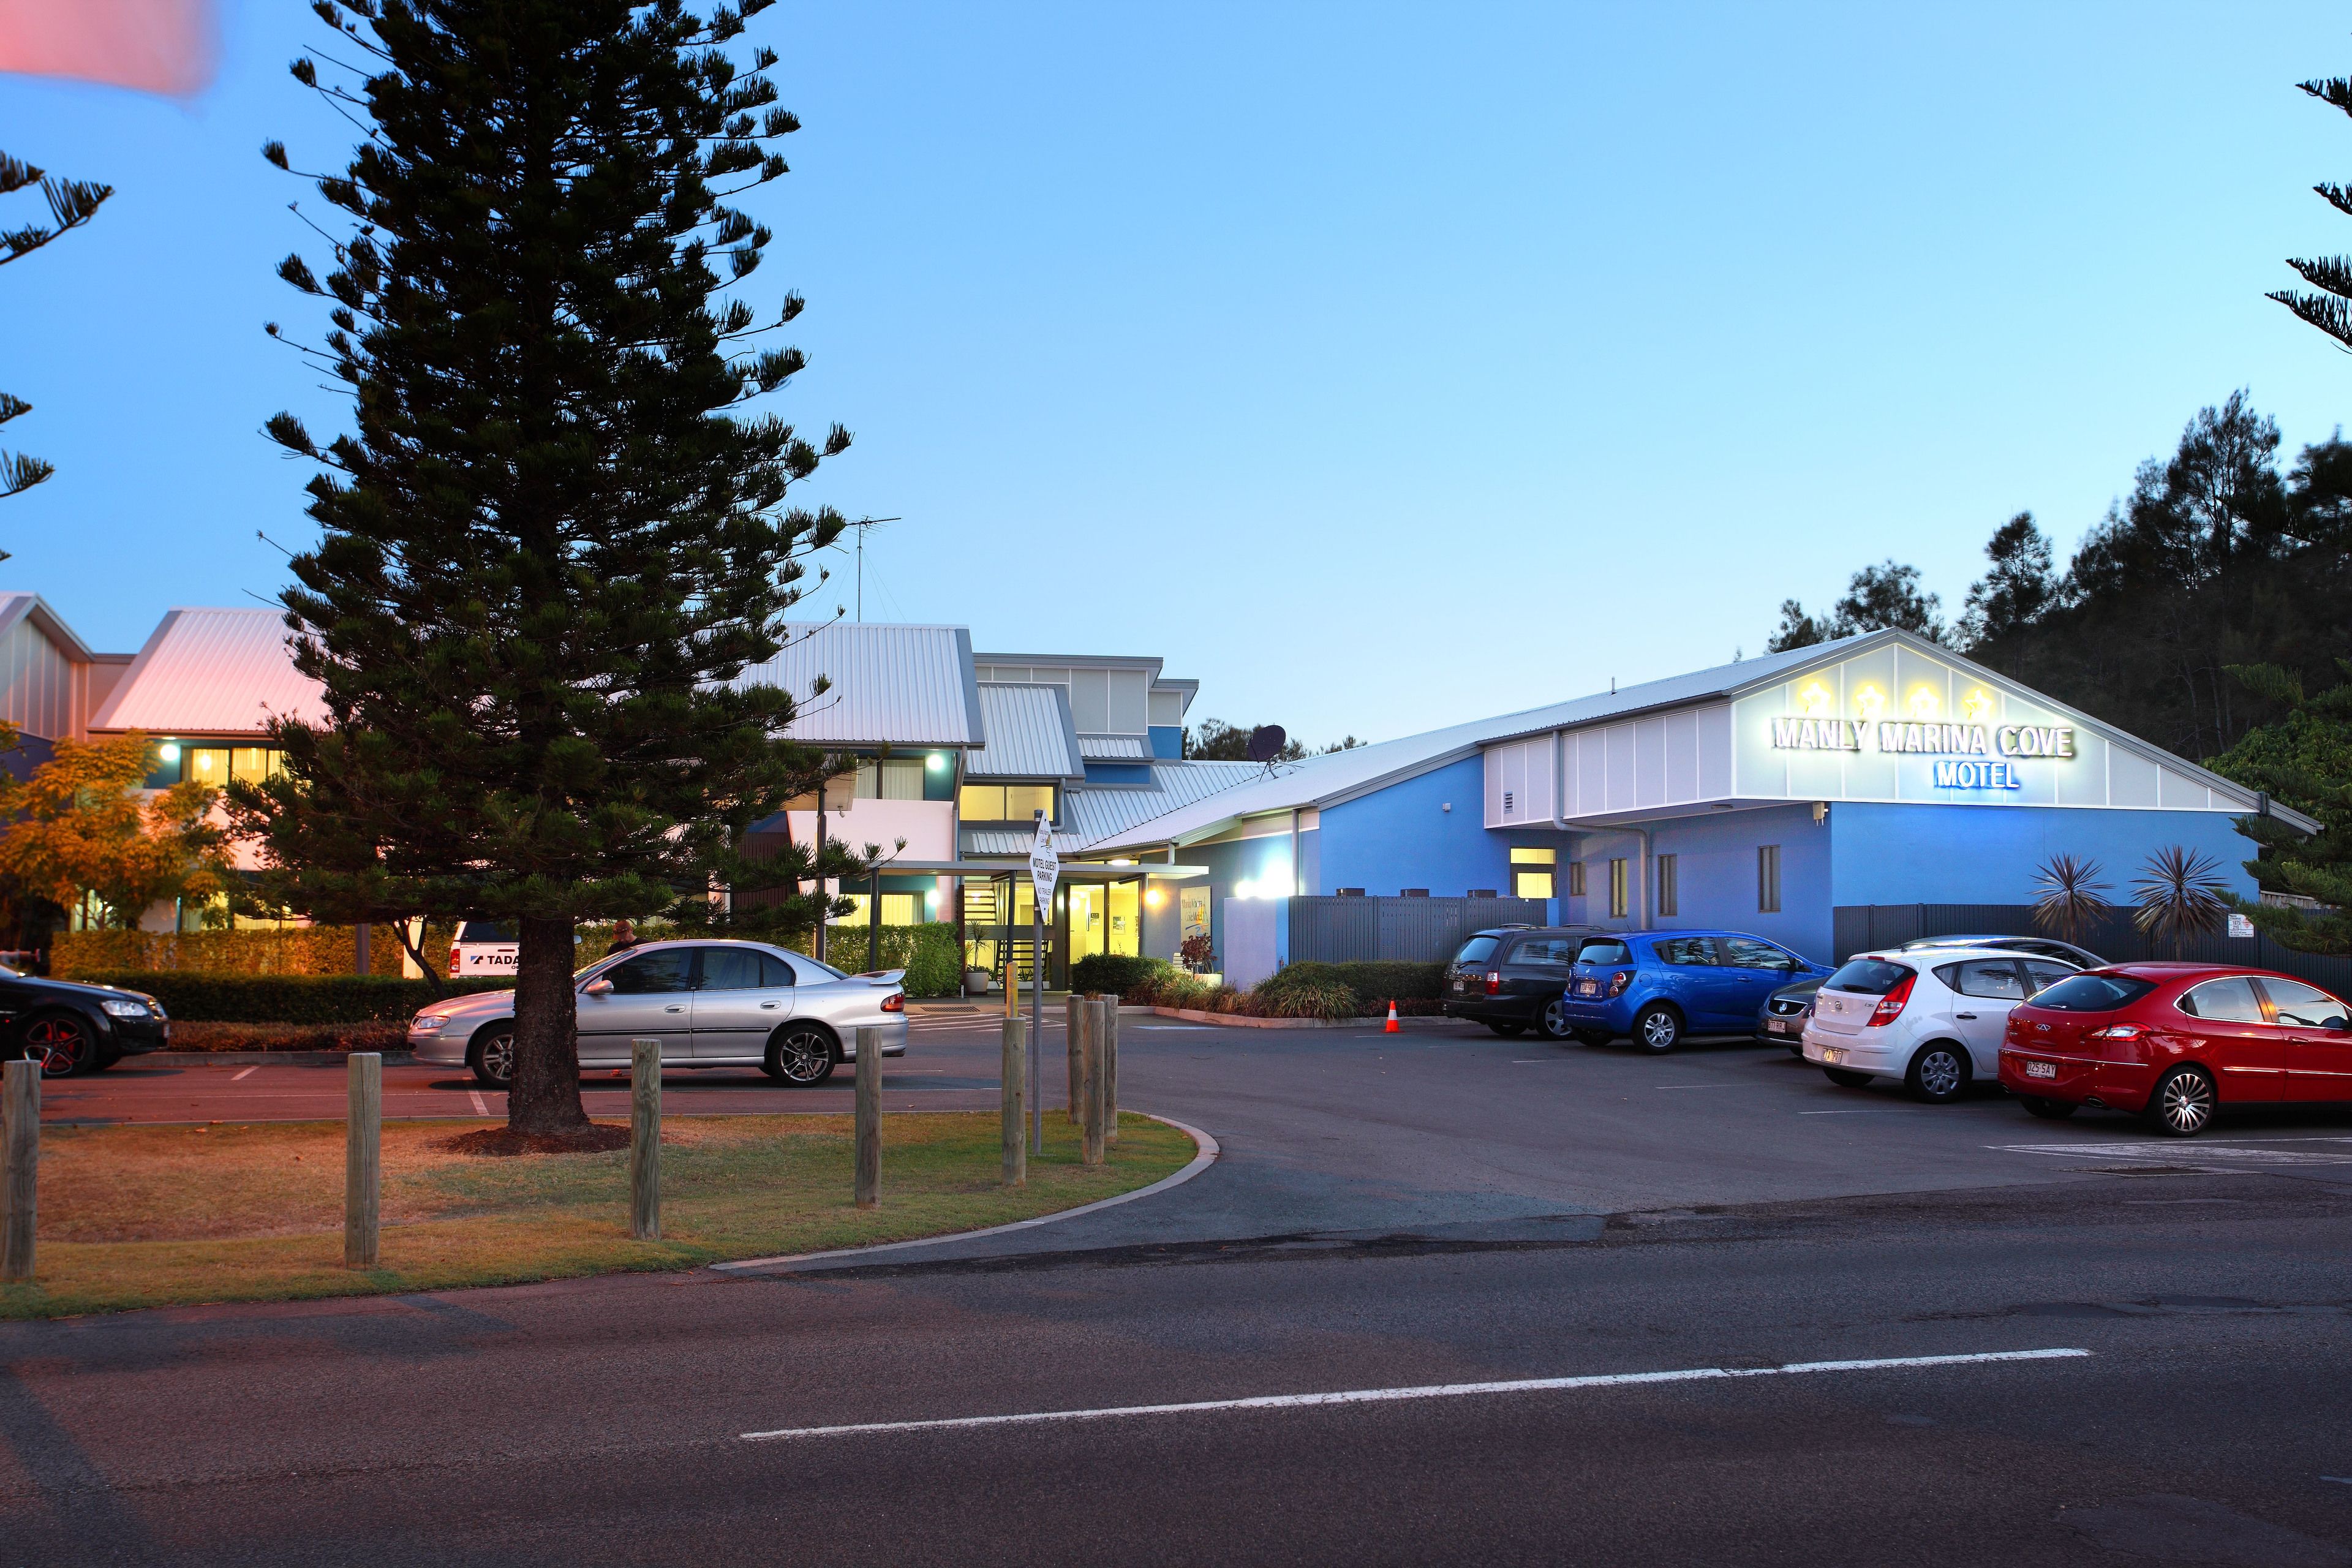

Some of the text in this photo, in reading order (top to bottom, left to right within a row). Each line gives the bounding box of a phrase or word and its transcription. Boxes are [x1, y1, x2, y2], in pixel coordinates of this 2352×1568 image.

[1773, 718, 2073, 756] MANLY MARINA COVE
[1936, 761, 2019, 788] MOTEL
[1033, 858, 1056, 871] MOTEL GUEST
[1037, 870, 1052, 882] PARKING
